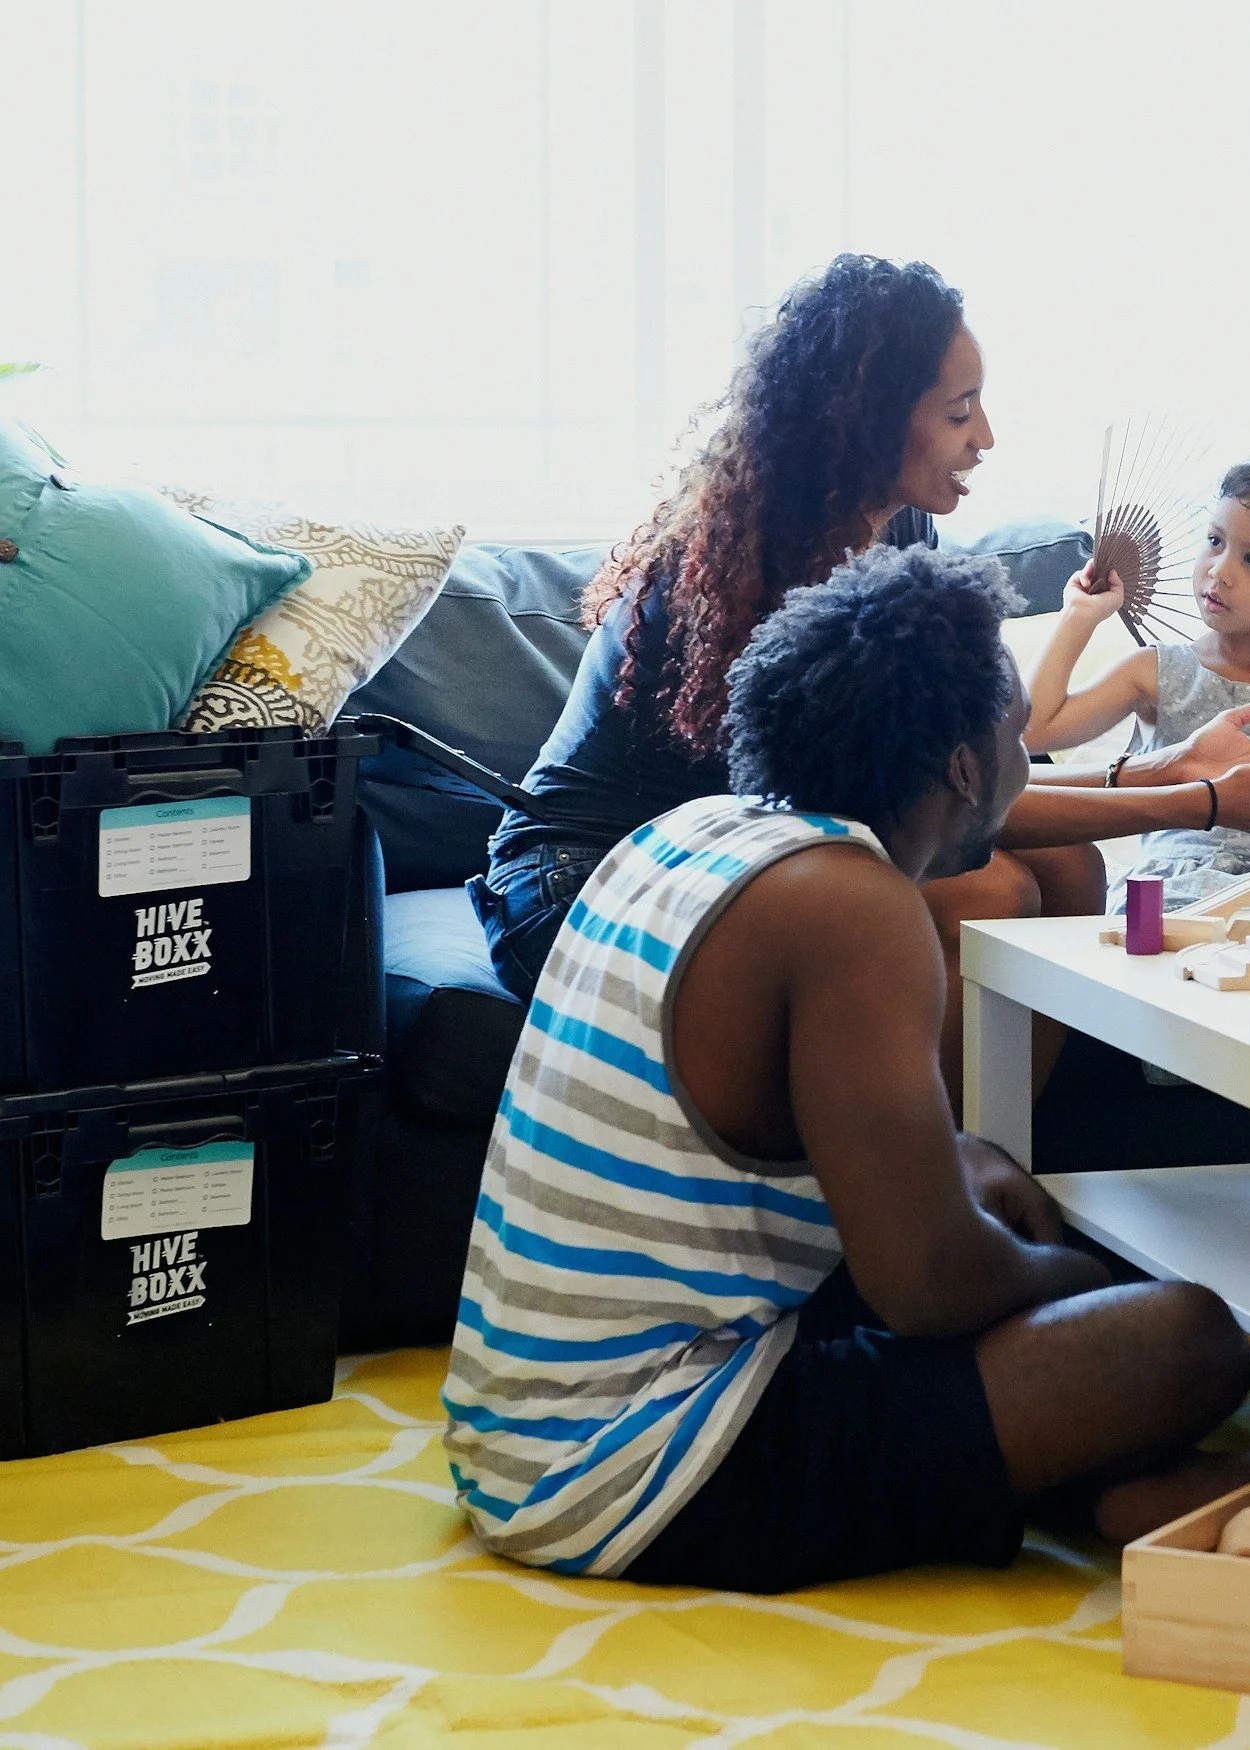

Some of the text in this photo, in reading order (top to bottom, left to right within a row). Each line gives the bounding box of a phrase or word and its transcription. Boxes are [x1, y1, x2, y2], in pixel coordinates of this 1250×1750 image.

[156, 807, 194, 818] Contents
[134, 898, 204, 938] HIVE
[132, 928, 212, 971] BOXX
[138, 965, 205, 984] MOVING MADE EASY
[160, 1151, 200, 1162] Contents
[129, 1231, 199, 1274] HIVE
[127, 1261, 208, 1307] BOXX
[133, 1298, 201, 1320] MOVING MADE EASY
